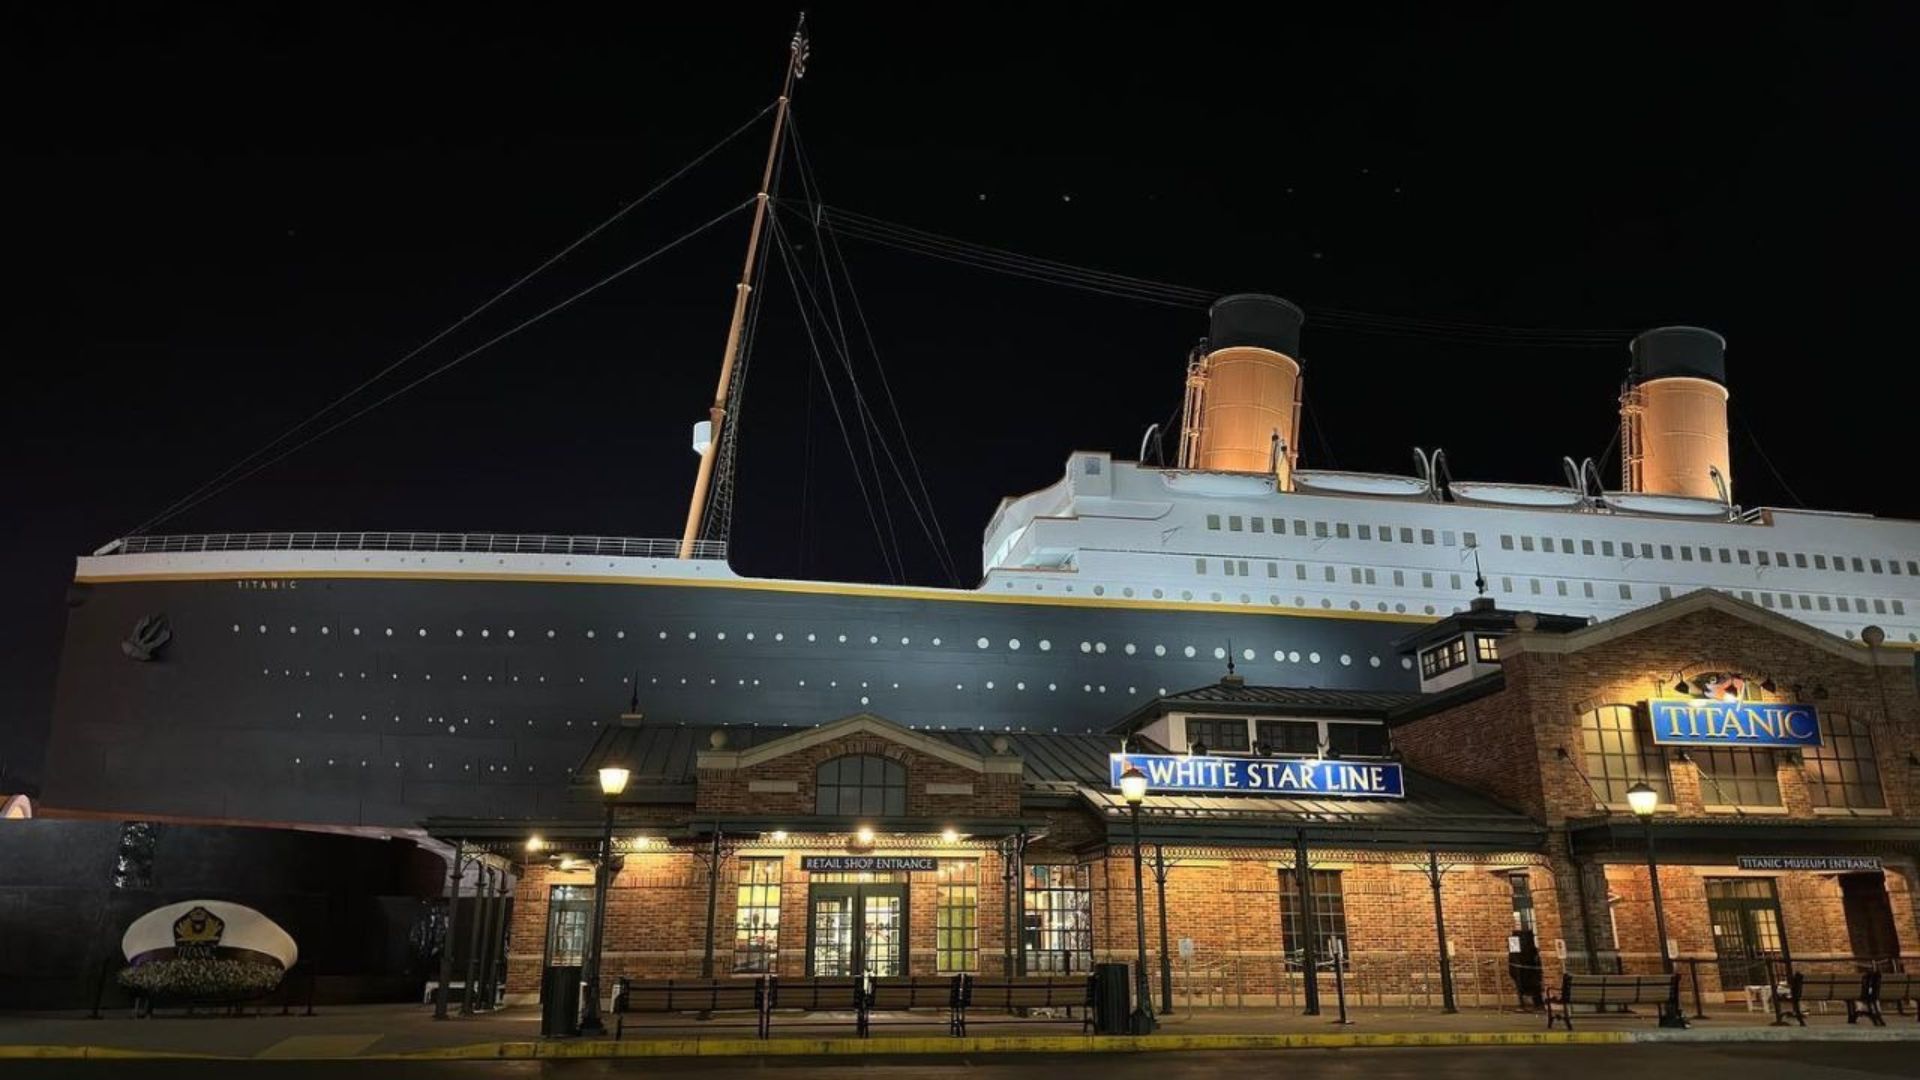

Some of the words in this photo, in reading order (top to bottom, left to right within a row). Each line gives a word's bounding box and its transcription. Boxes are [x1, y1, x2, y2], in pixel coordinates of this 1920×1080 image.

[238, 580, 297, 589] TITANIC
[1661, 705, 1813, 739] TITANIC
[1147, 759, 1238, 787] WHITE
[1248, 763, 1318, 789] STAR
[1326, 766, 1386, 791] LINE
[806, 857, 842, 869] RETAIL
[844, 857, 874, 869] SHOP
[876, 857, 933, 869] ENTRANCE
[1742, 858, 1780, 868] TITANIC
[1783, 859, 1826, 869] MUSEUM
[1829, 859, 1879, 869] ENTRANCE
